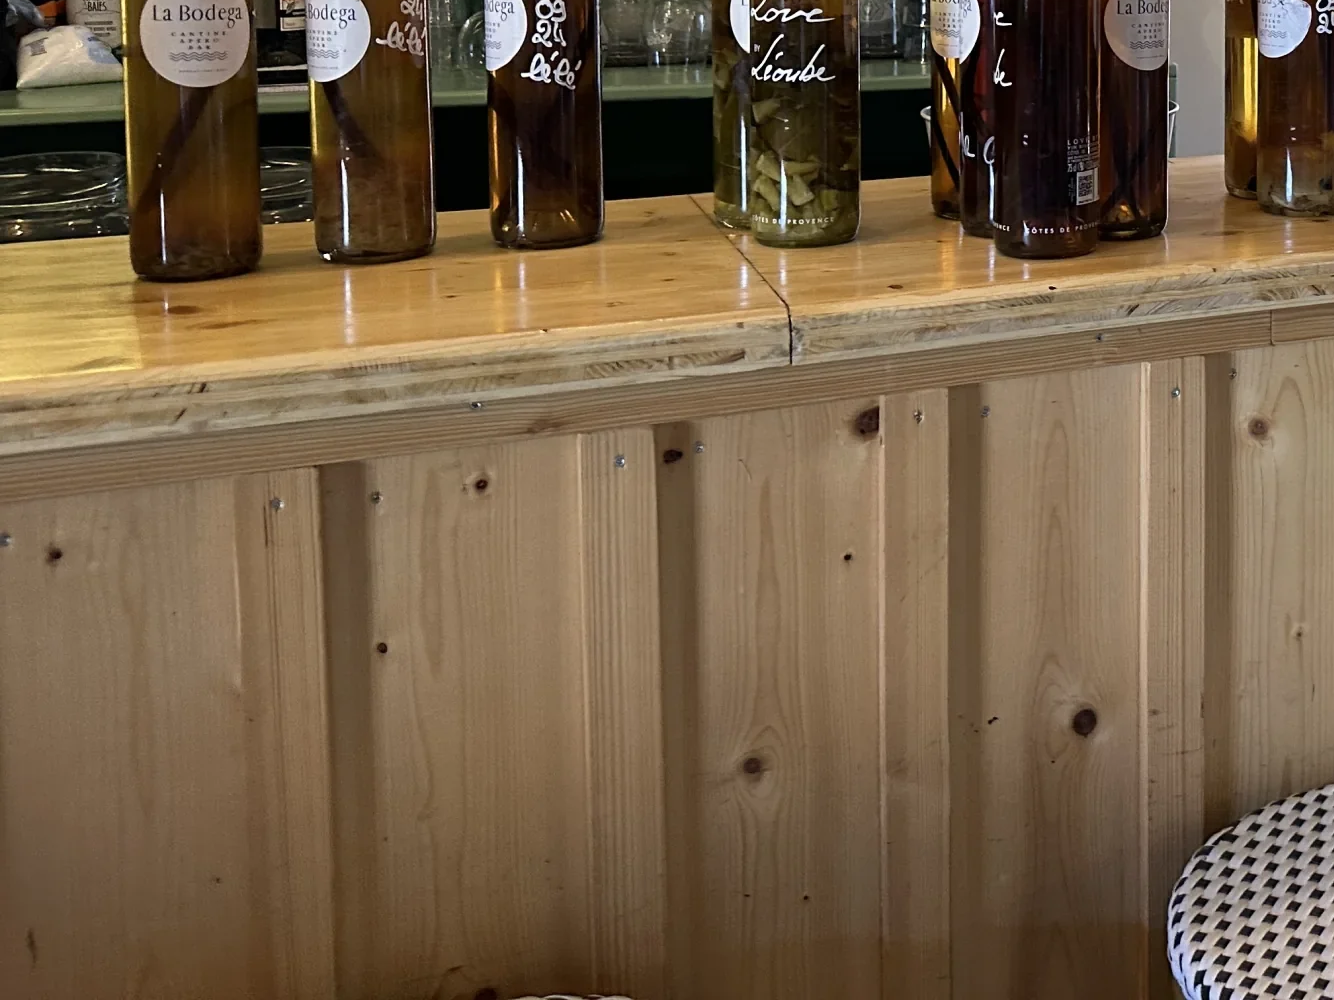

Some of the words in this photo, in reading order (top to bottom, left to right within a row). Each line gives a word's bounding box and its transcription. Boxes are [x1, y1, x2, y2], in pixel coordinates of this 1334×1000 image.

[1117, 0, 1133, 16] La
[152, 4, 173, 22] La
[179, 3, 243, 29] Bodega
[308, 3, 357, 30] Bodega
[753, 43, 761, 53] BY
[787, 216, 835, 226] PROVENCE
[1059, 226, 1071, 234] DE
